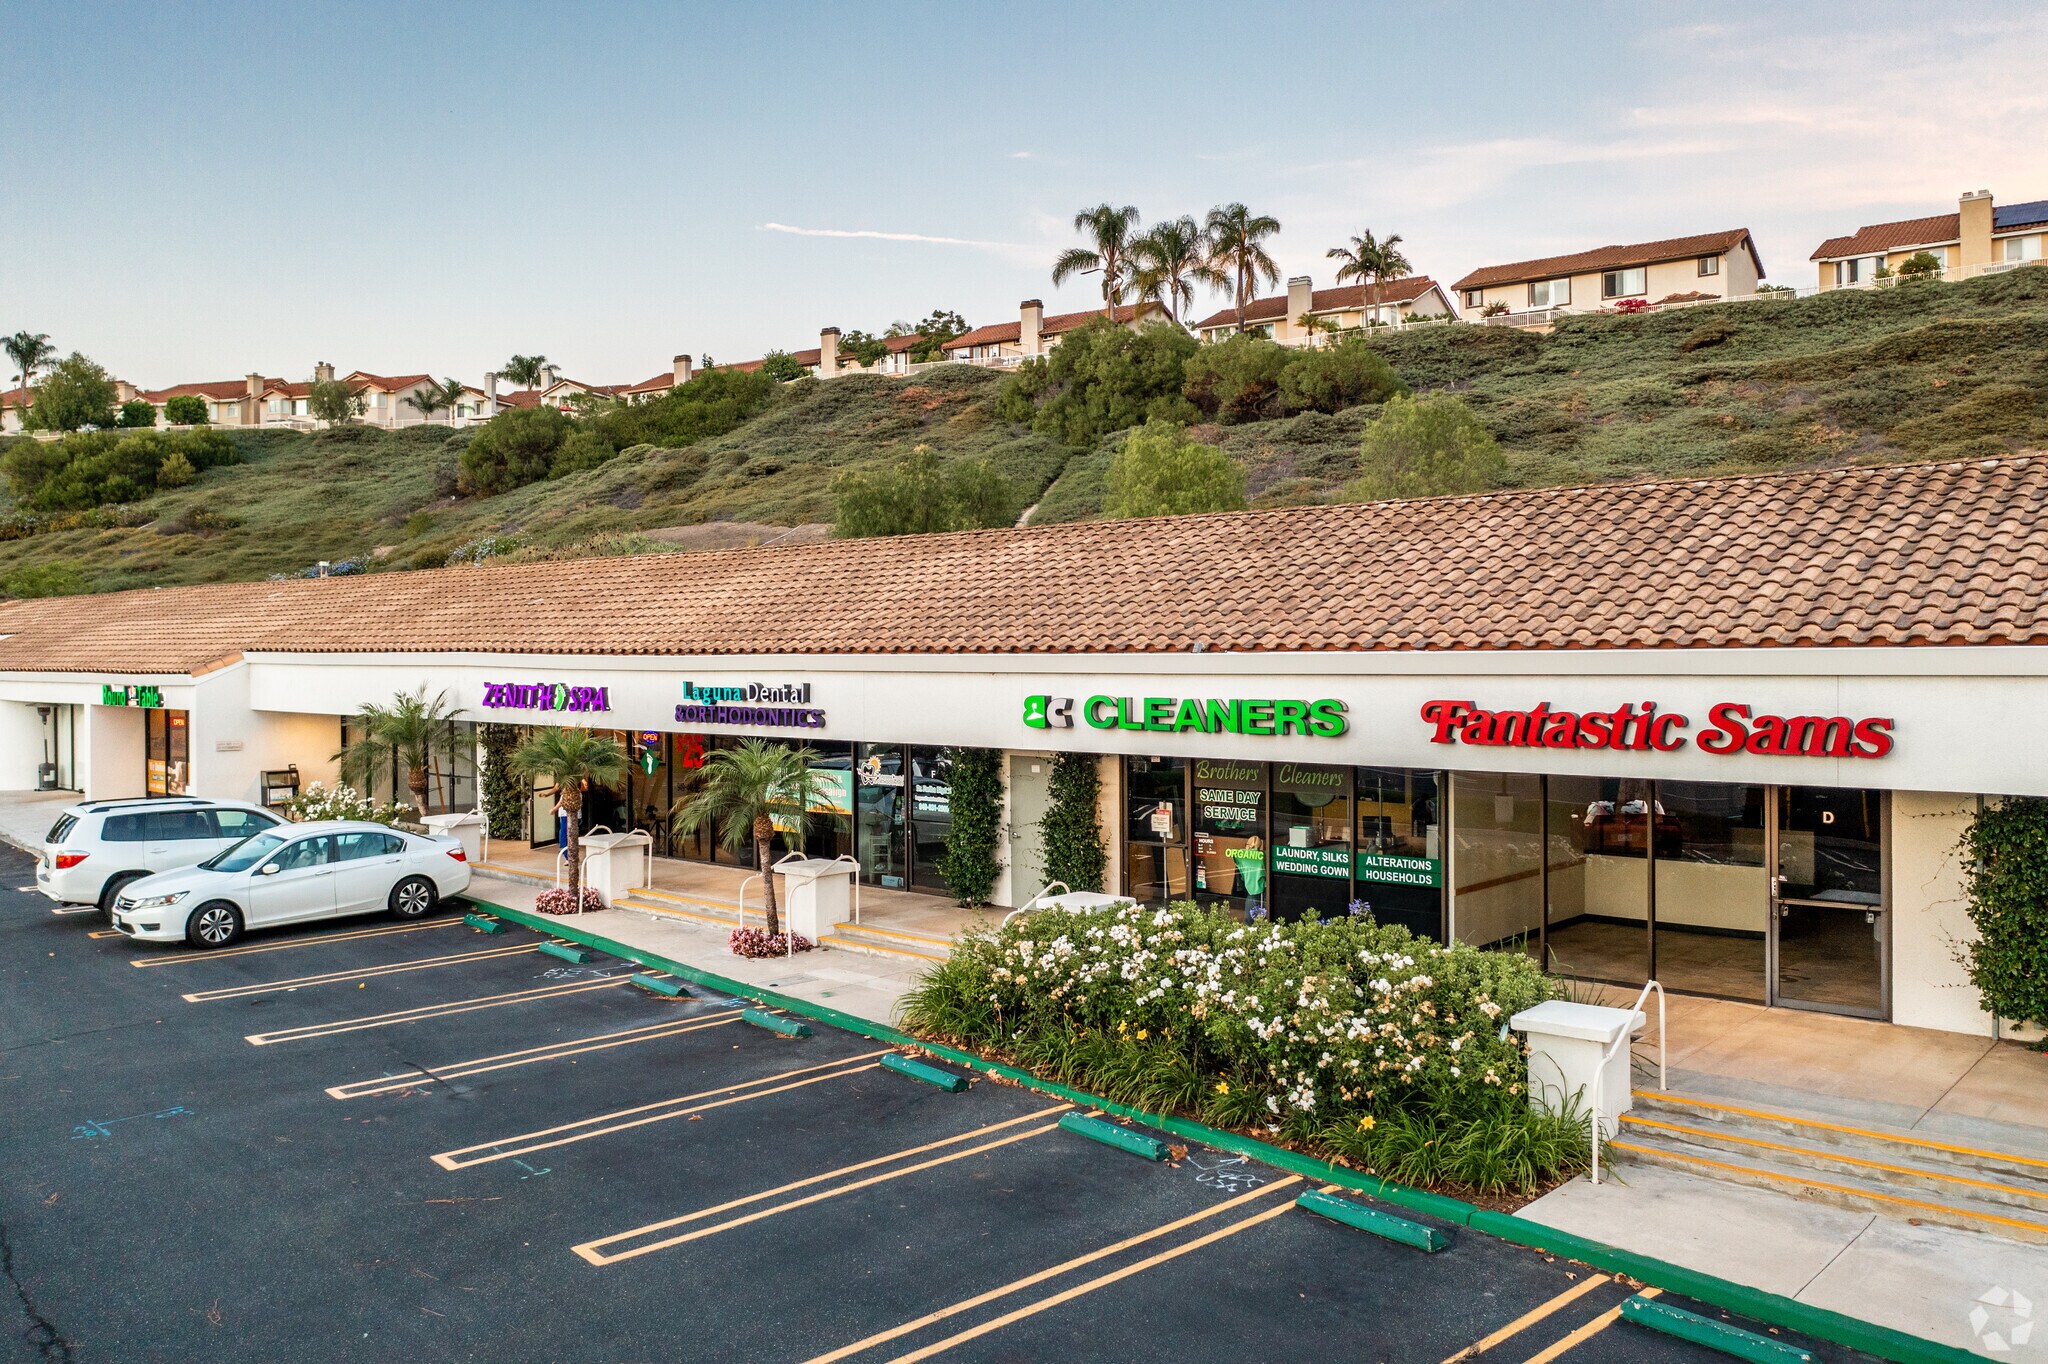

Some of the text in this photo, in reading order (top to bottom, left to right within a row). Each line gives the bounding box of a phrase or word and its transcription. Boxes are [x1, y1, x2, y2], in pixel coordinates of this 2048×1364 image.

[102, 684, 159, 708] Round Table
[482, 682, 609, 712] ZENITH SPA
[683, 681, 806, 706] Laguna Dental
[173, 718, 185, 726] OPEN
[1083, 695, 1347, 737] CLEANERS
[642, 733, 658, 741] OPEN
[1421, 700, 1894, 759] Fantastic Sams
[931, 770, 937, 778] F
[1197, 760, 1344, 787] Brothers' Cleaners
[1200, 789, 1261, 804] SAME DAY
[1204, 806, 1257, 820] SERVICE
[1822, 811, 1835, 824] D
[1225, 848, 1264, 860] ORGANIC
[1276, 847, 1349, 863] LAUNDRY, SILKS
[1276, 861, 1349, 877] WEDDING GOWN
[1366, 856, 1432, 871] ALTERATIONS
[1366, 870, 1433, 885] HOUSEHOLDS
